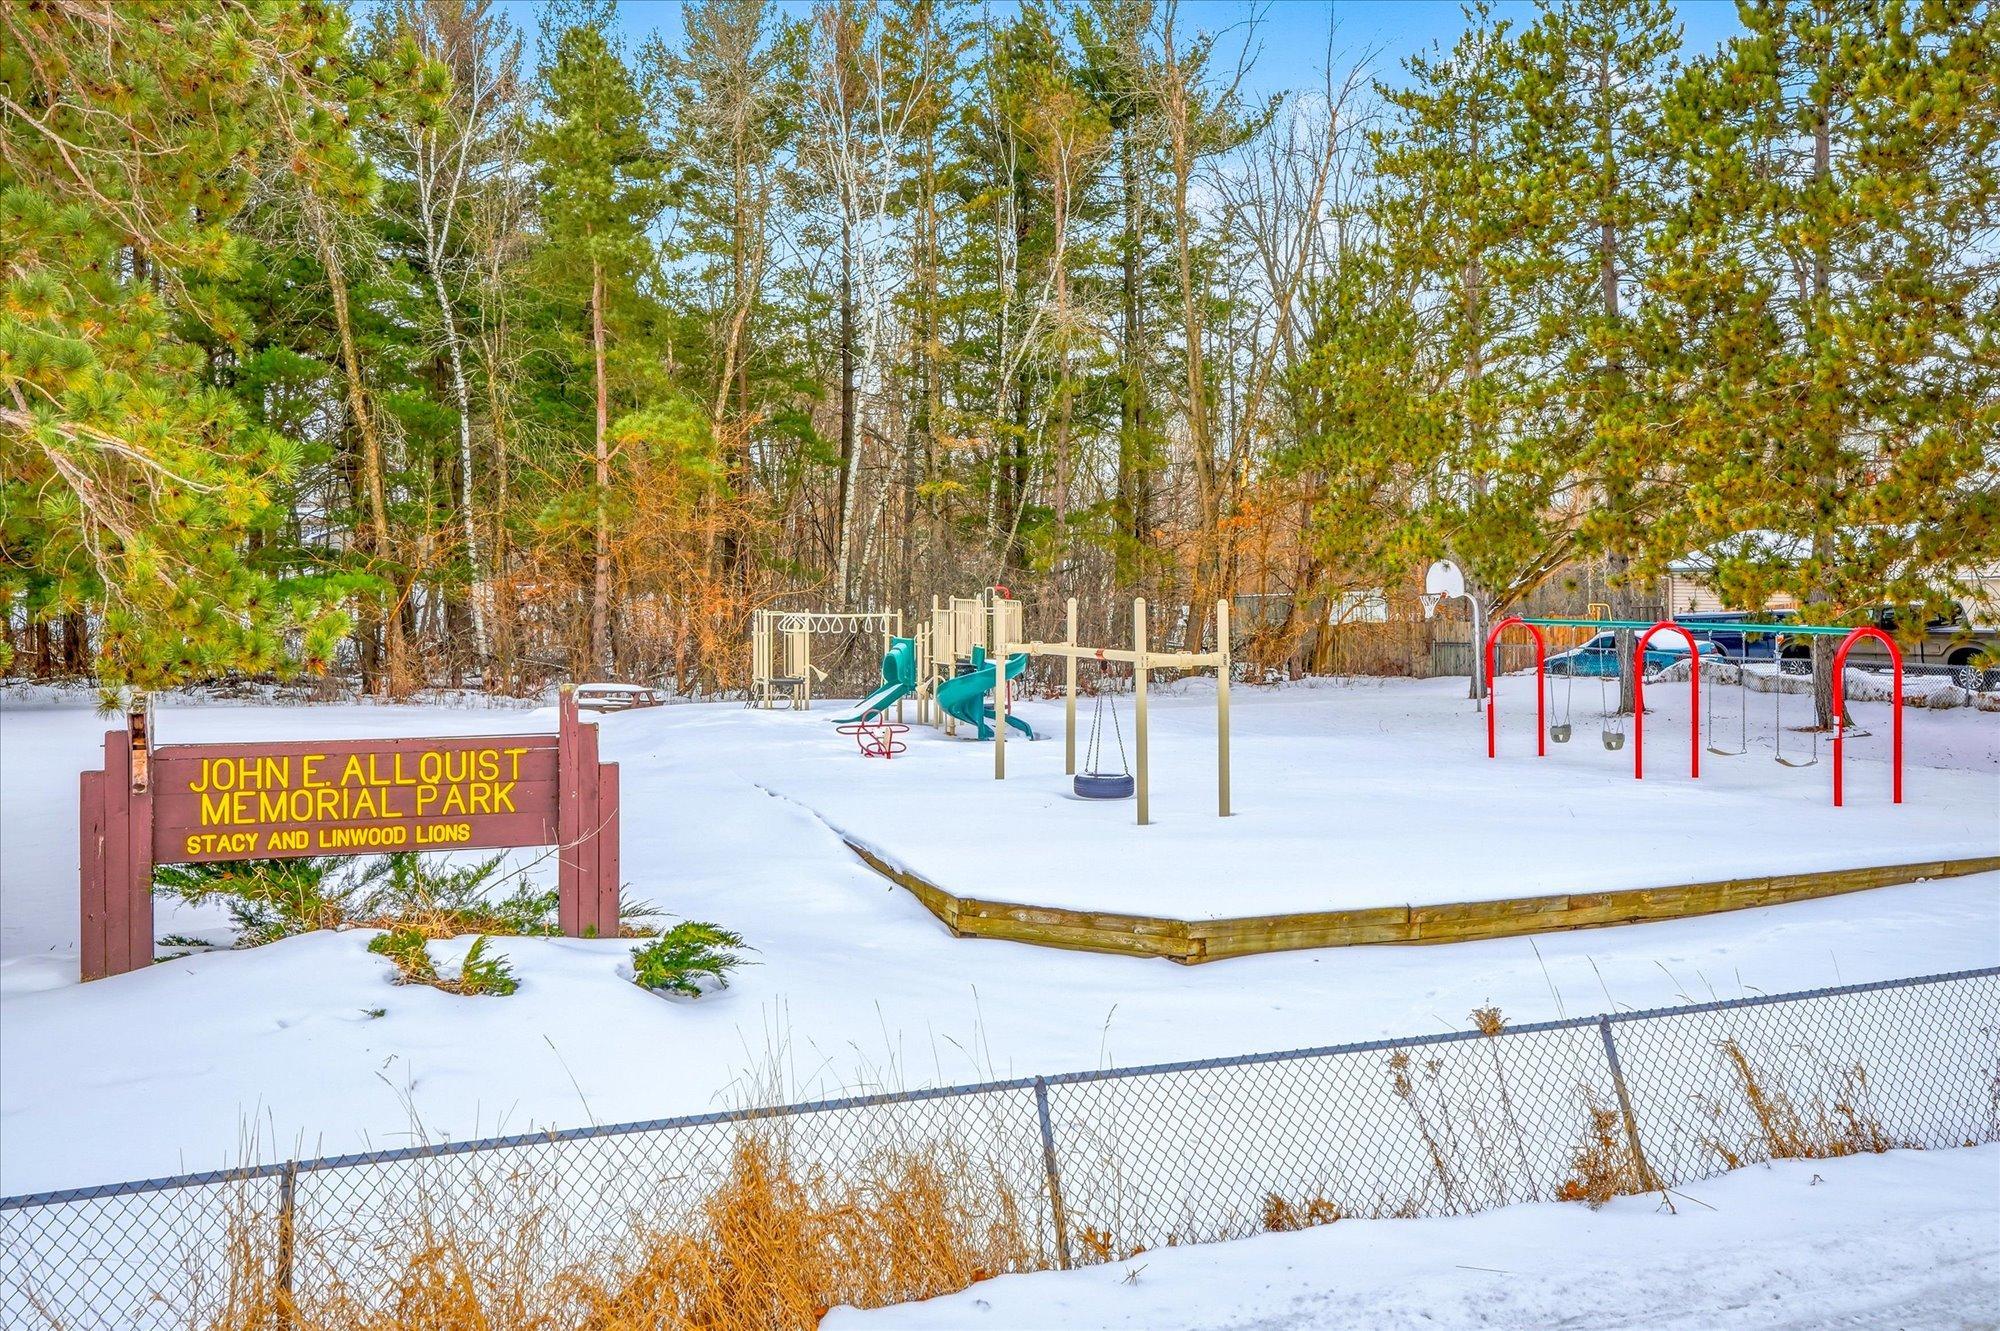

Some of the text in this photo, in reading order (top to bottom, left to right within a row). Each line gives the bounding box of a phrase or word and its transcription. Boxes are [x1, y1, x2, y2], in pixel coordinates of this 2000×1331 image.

[189, 748, 529, 793] JOHN E. ALLQUIST
[201, 781, 516, 826] MEMORIAL PARK
[186, 823, 472, 855] STACY AND LINWOOD LIONS
